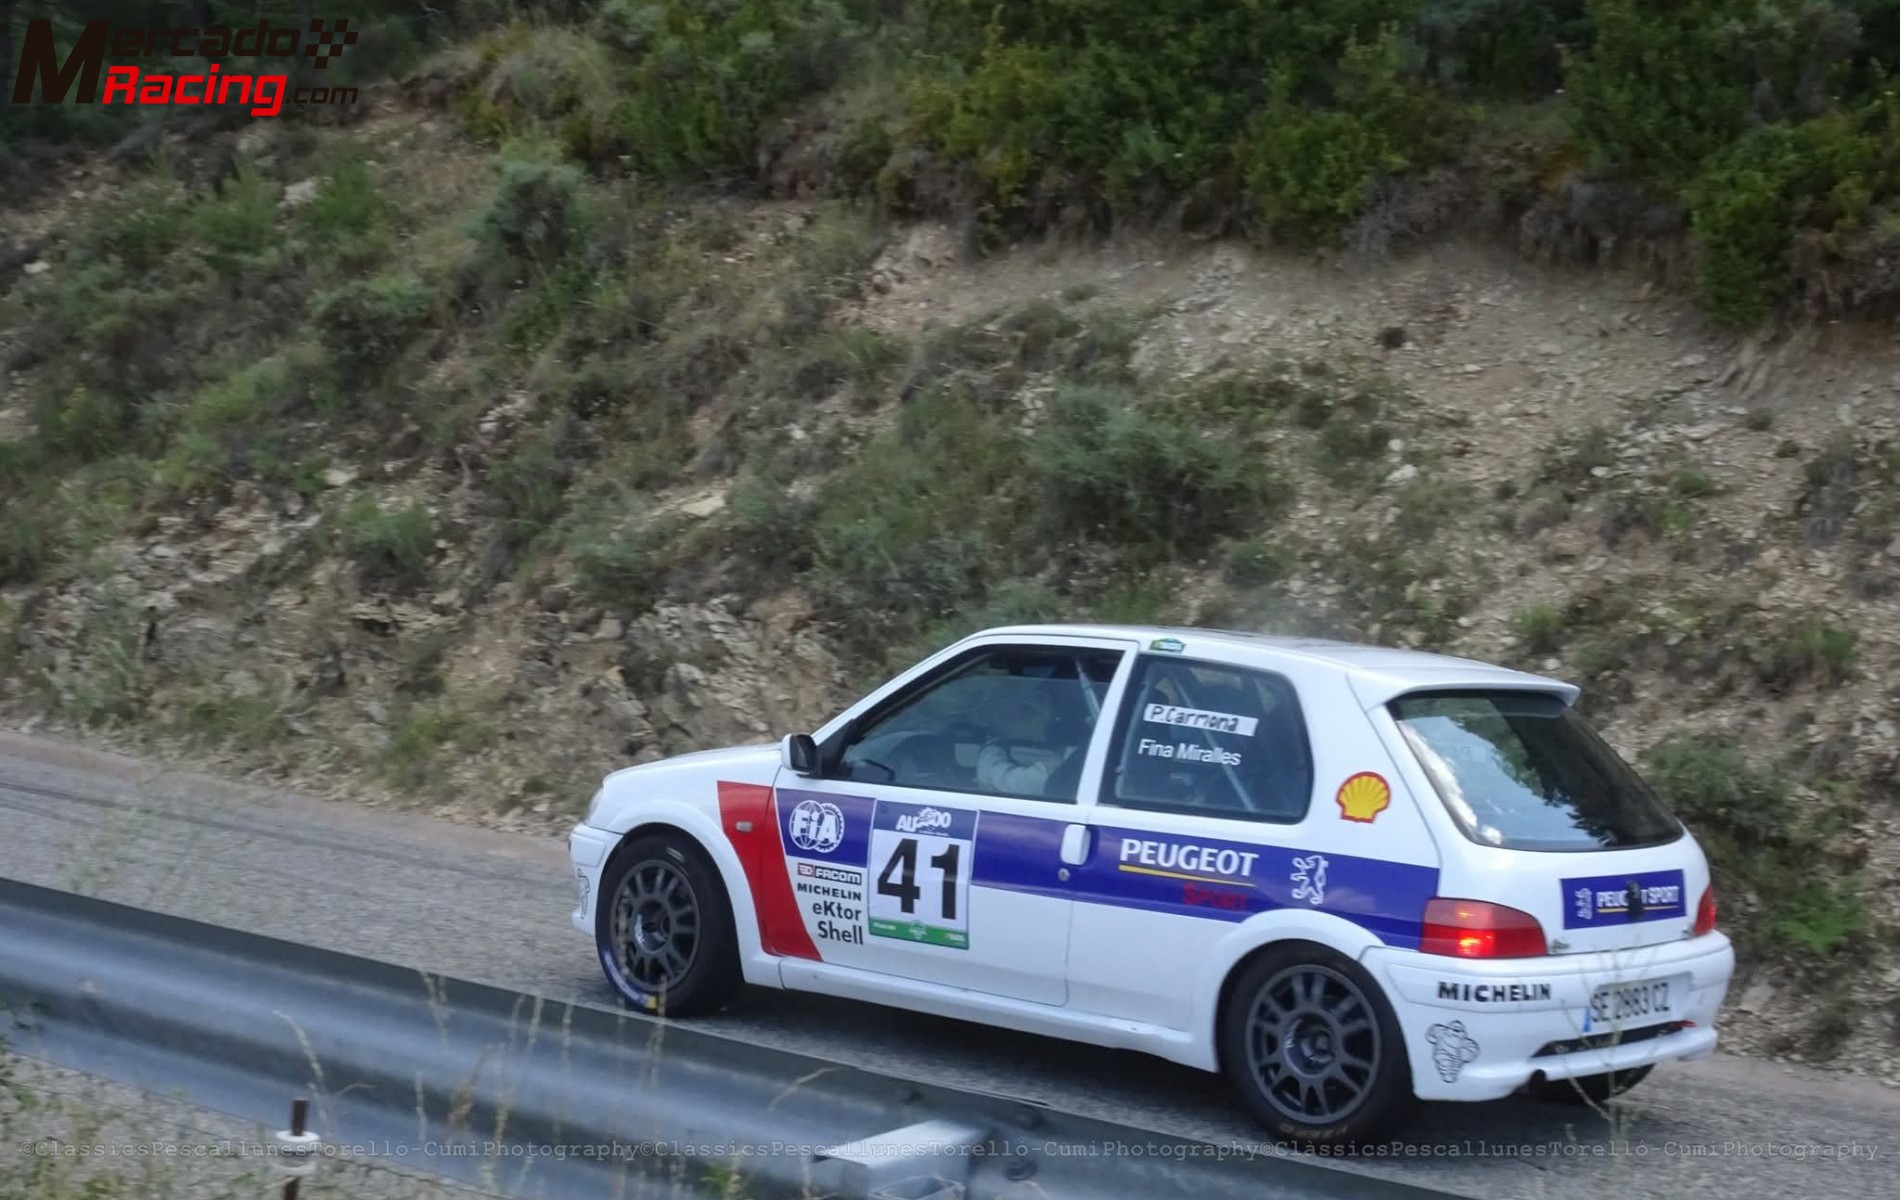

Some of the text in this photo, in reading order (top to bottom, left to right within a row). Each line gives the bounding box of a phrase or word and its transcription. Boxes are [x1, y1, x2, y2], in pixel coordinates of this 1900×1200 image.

[1137, 738, 1242, 766] Fina Miralles
[1119, 838, 1259, 877] PEUGEOT
[877, 837, 961, 920] 41
[797, 882, 862, 902] MICHELIN
[812, 900, 862, 921] eKtor
[817, 920, 864, 946] Shell
[1438, 981, 1552, 1002] MICHELIN
